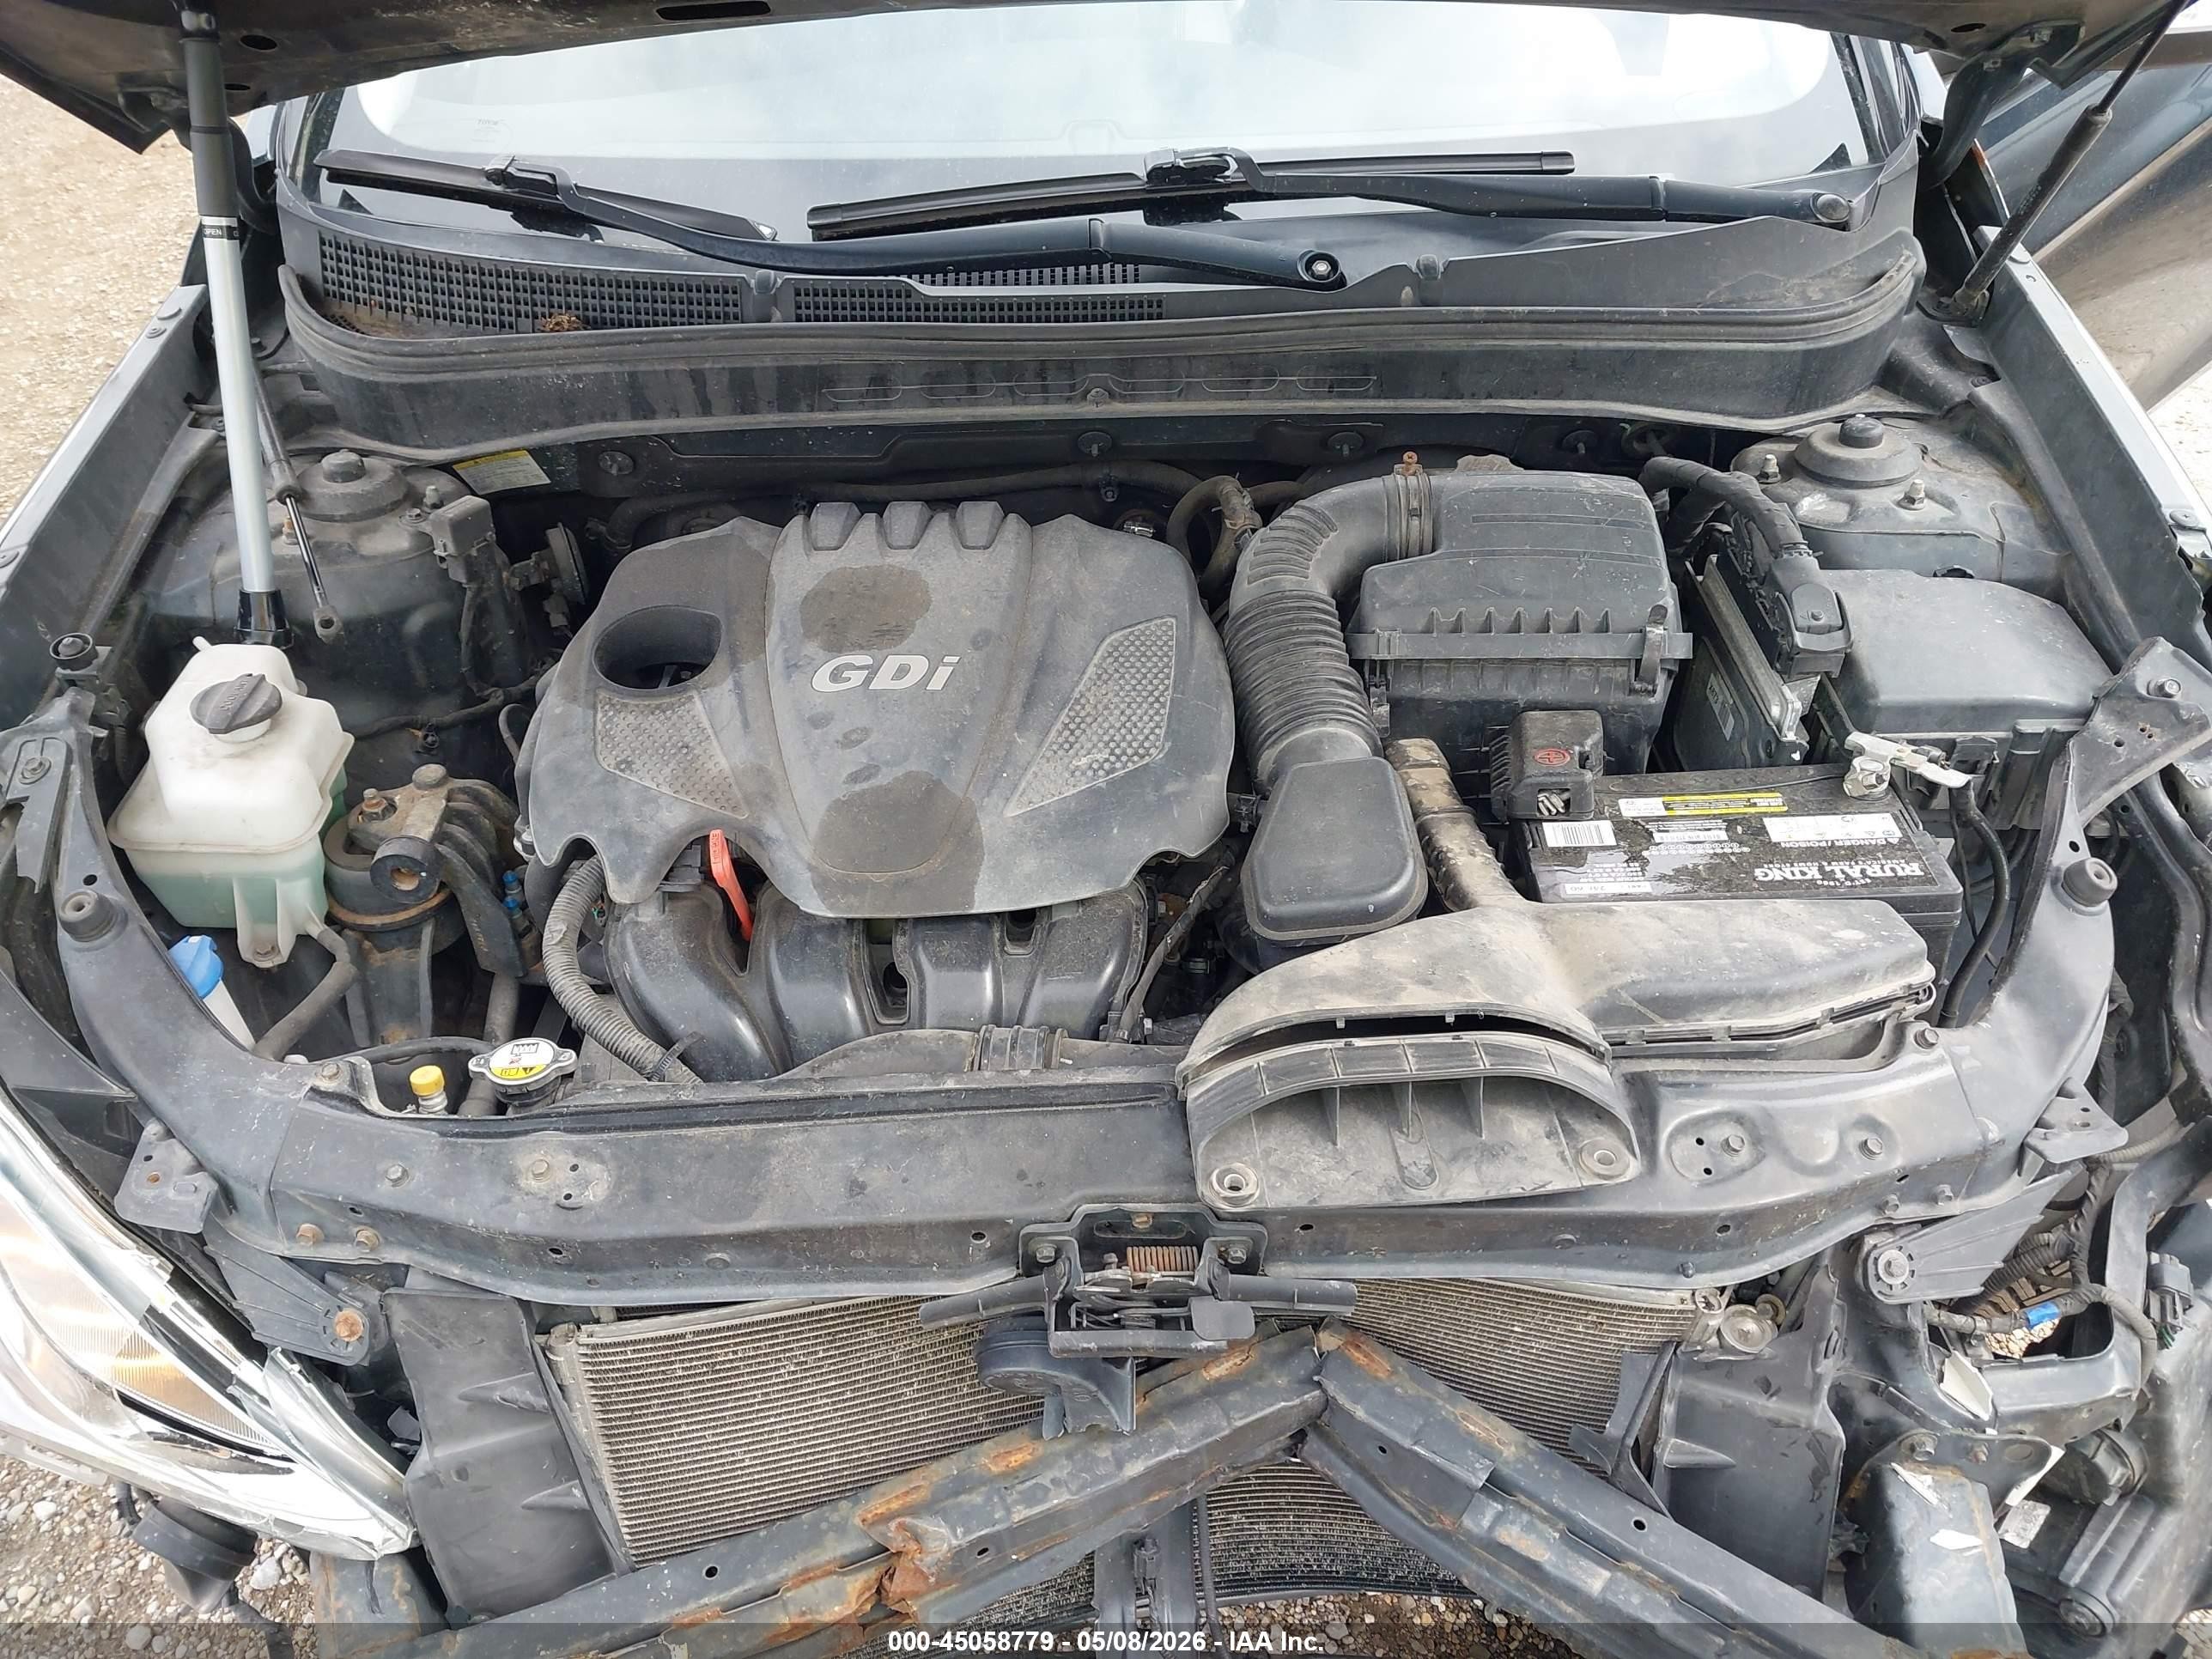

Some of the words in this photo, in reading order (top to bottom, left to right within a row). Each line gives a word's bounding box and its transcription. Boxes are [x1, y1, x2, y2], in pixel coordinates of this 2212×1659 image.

[811, 654, 961, 692] GDi
[1754, 866, 1823, 881] KING
[1825, 862, 1924, 878] RURAL
